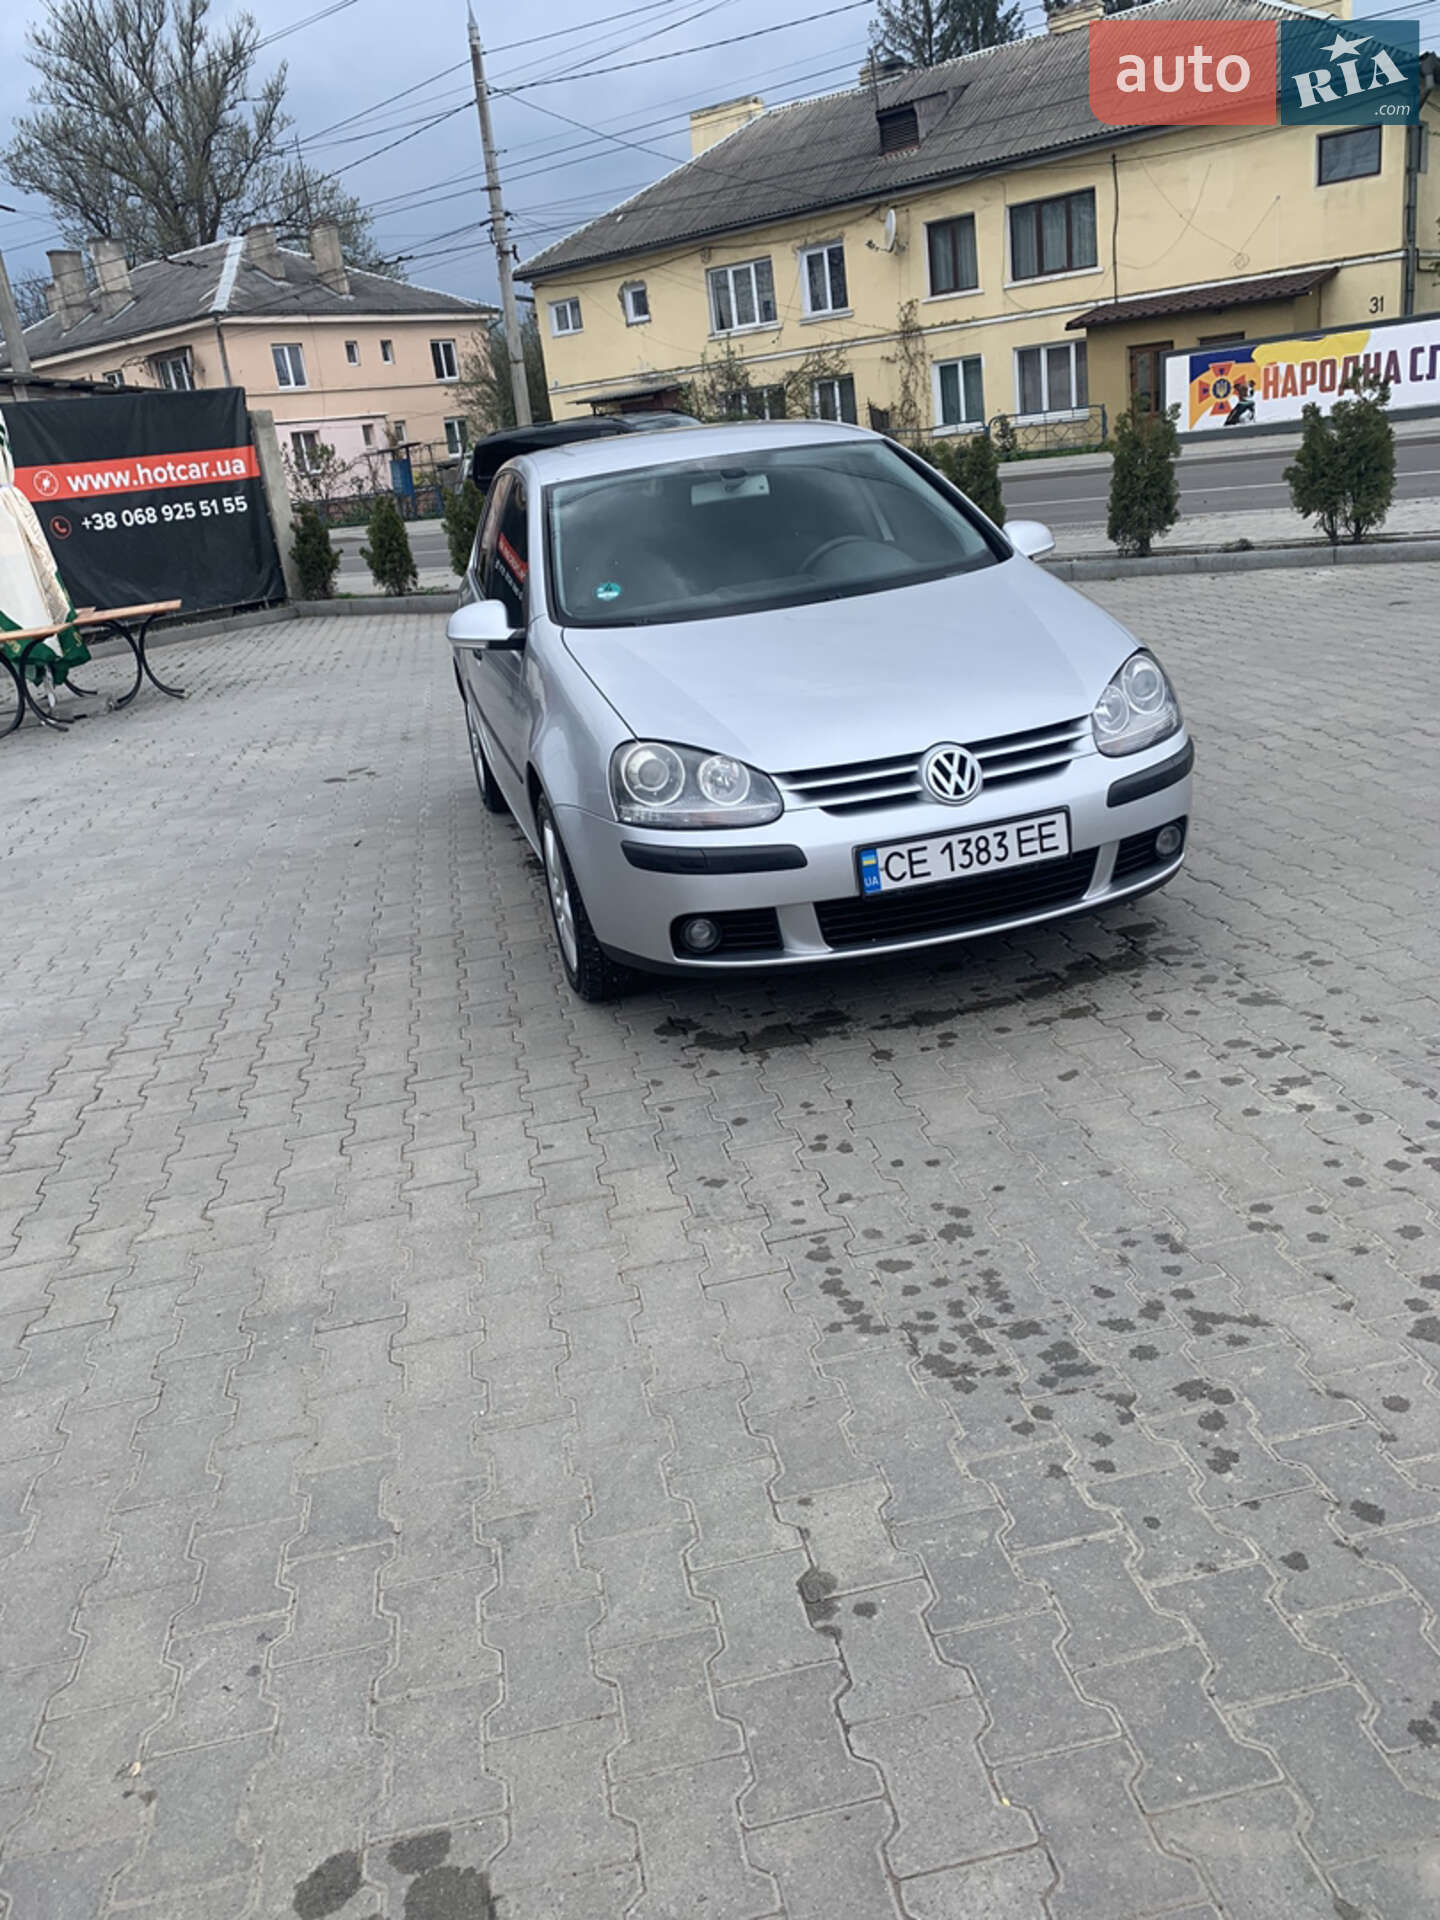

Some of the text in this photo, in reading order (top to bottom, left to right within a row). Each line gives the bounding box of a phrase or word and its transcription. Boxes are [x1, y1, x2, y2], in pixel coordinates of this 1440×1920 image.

[1368, 296, 1385, 314] 31
[1261, 349, 1402, 401] НАРОДНА
[66, 457, 247, 493] www.hotcar.ua
[81, 495, 249, 531] +38 068 925 51 55
[884, 820, 1060, 882] CE 1383 EE
[863, 876, 880, 888] UA
